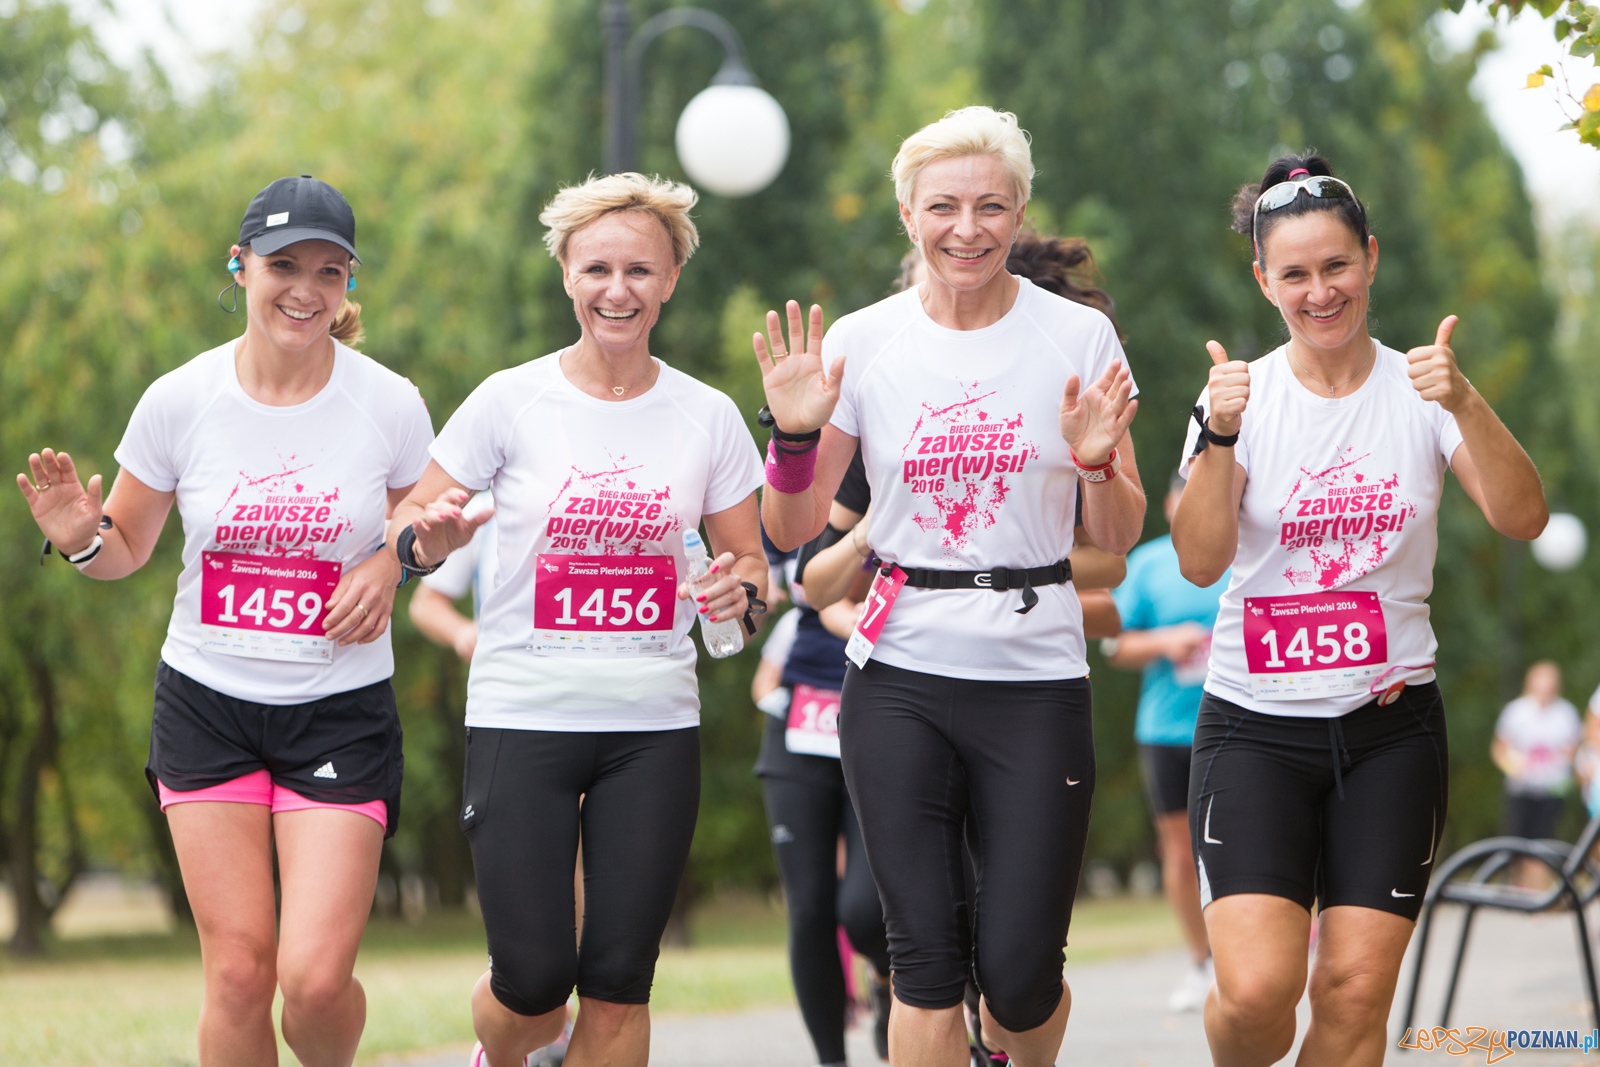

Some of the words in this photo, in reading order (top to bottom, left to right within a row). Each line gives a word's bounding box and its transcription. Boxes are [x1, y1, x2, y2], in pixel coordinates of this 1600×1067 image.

[950, 425, 970, 434] BIEG
[971, 424, 1004, 433] KOBIET
[917, 432, 1015, 455] zawsze
[903, 449, 1029, 483] pier(w)si!
[911, 478, 945, 493] 2016
[1328, 488, 1348, 497] BIEG
[1349, 484, 1381, 495] KOBIET
[265, 495, 286, 504] BIEG
[287, 496, 320, 505] KOBIET
[598, 490, 619, 499] BIEG
[619, 491, 652, 502] KOBIET
[1296, 492, 1393, 517] zawsze
[231, 504, 331, 523] zawsze
[564, 497, 662, 521] zawsze
[215, 523, 344, 548] pier(w)si!
[546, 516, 672, 545] pier(w)si!
[1280, 508, 1407, 545] pier(w)si!
[222, 541, 259, 550] 2016
[550, 536, 588, 550] 2016
[1286, 536, 1323, 551] 2016
[231, 563, 260, 575] Zawsze
[262, 566, 295, 579] Pier(w)si
[296, 569, 318, 580] 2016
[568, 566, 598, 575] Zawsze
[600, 567, 633, 576] Pier(w)si
[634, 566, 654, 575] 2016
[217, 584, 322, 630] 1459
[553, 587, 660, 626] 1456
[1270, 607, 1299, 617] Zawsze
[1300, 603, 1335, 615] Pier(w)si
[1336, 601, 1358, 611] 2016
[1260, 621, 1371, 668] 1458
